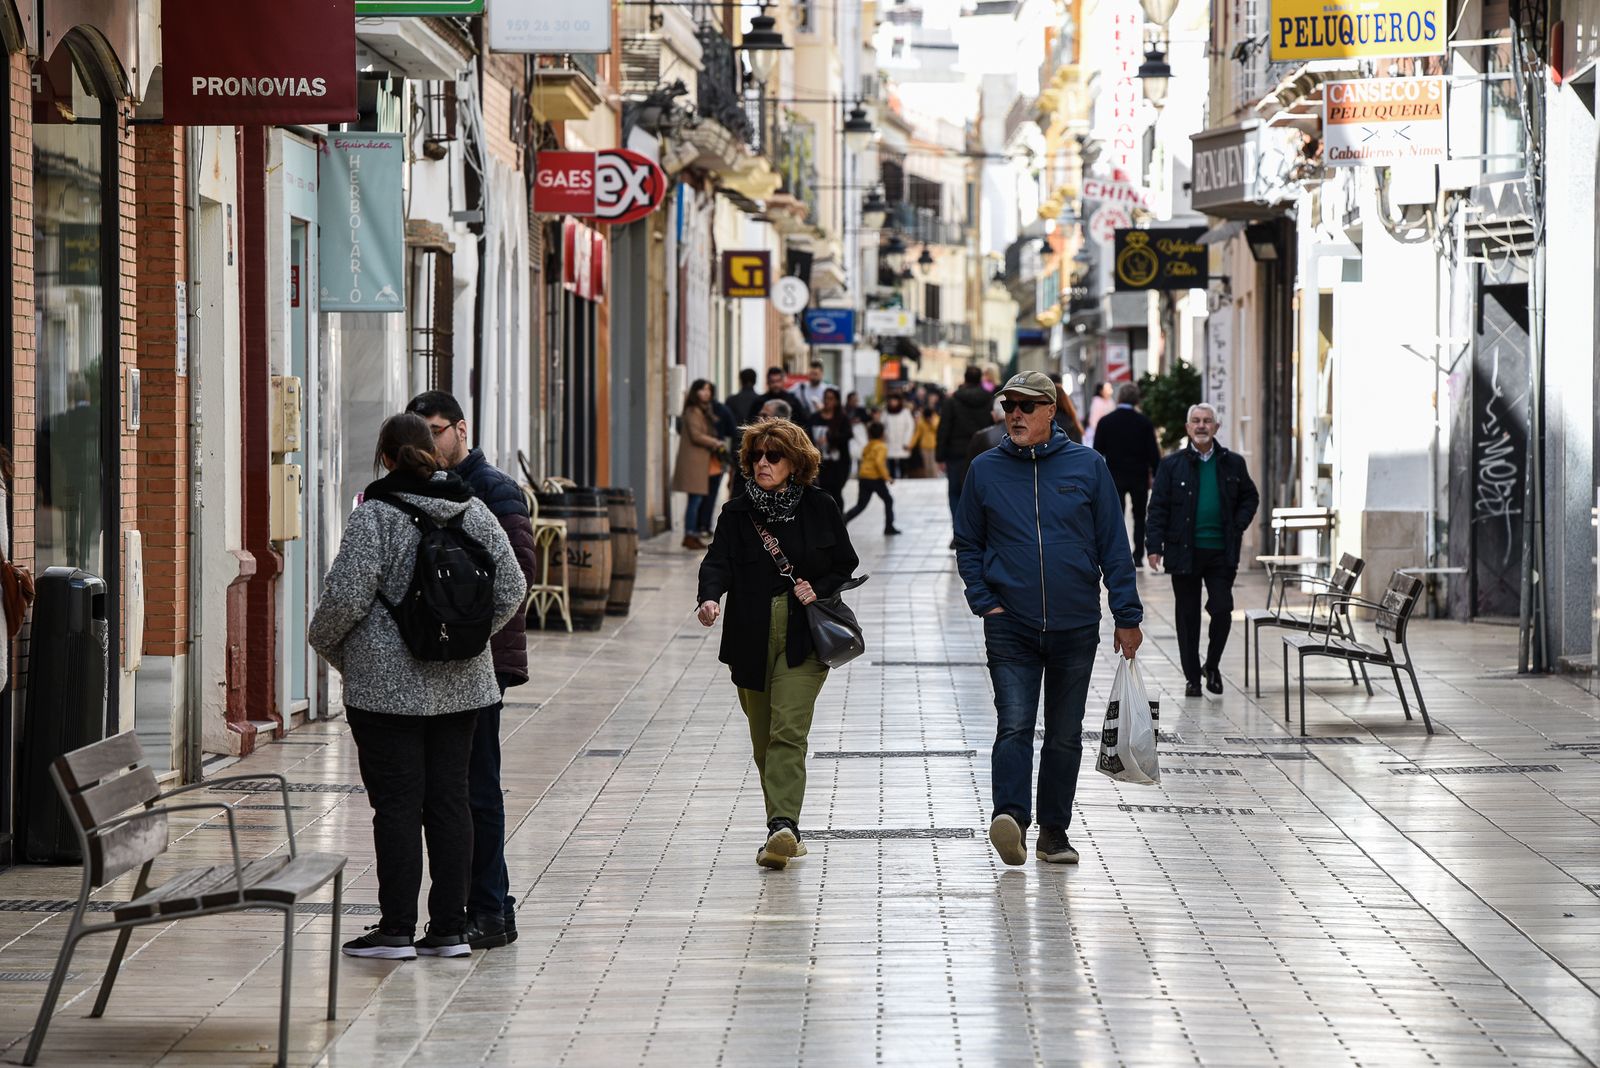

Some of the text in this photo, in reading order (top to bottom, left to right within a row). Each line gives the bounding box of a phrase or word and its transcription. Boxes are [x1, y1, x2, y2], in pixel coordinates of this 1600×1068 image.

[506, 19, 591, 31] 959 26 30 00
[1279, 11, 1436, 48] PELUQUEROS
[192, 77, 326, 96] PRONOVIAS
[334, 138, 393, 151] Equinácea
[537, 170, 593, 188] GAES
[349, 155, 362, 303] HERBOLARIO
